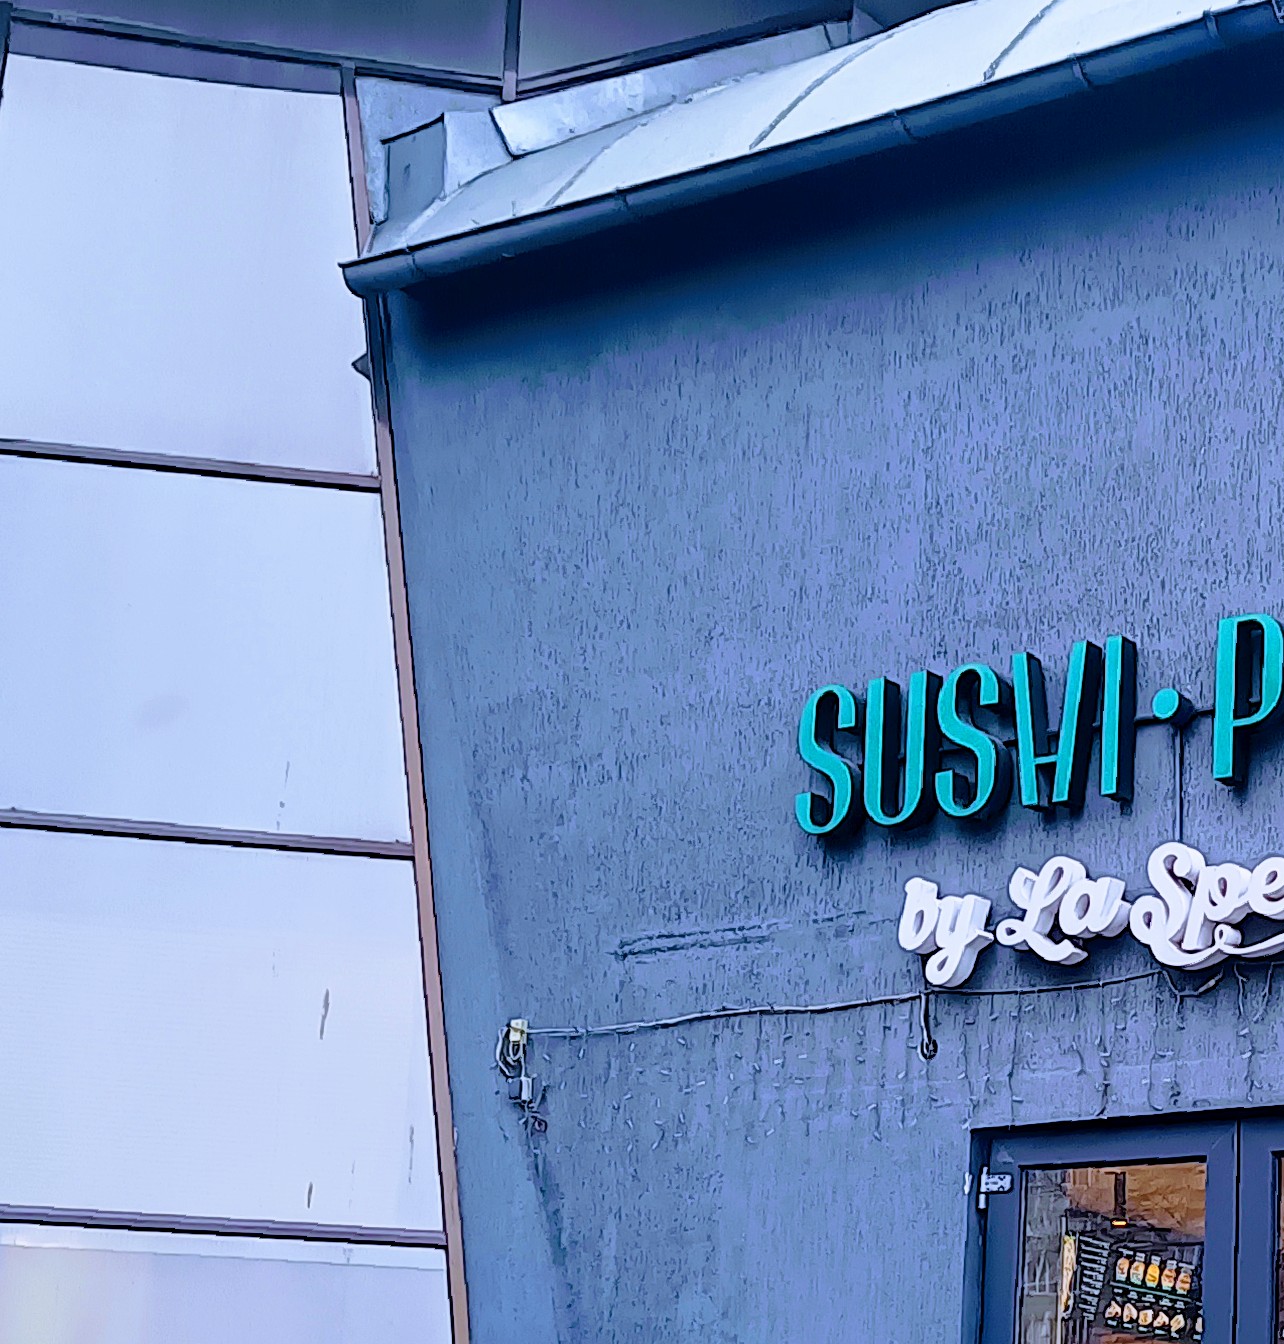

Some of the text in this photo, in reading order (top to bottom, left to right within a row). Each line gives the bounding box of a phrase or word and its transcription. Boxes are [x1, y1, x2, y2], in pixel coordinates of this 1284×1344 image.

[794, 633, 1137, 836] SUSHI
[898, 876, 993, 987] by
[996, 855, 1133, 964] La
